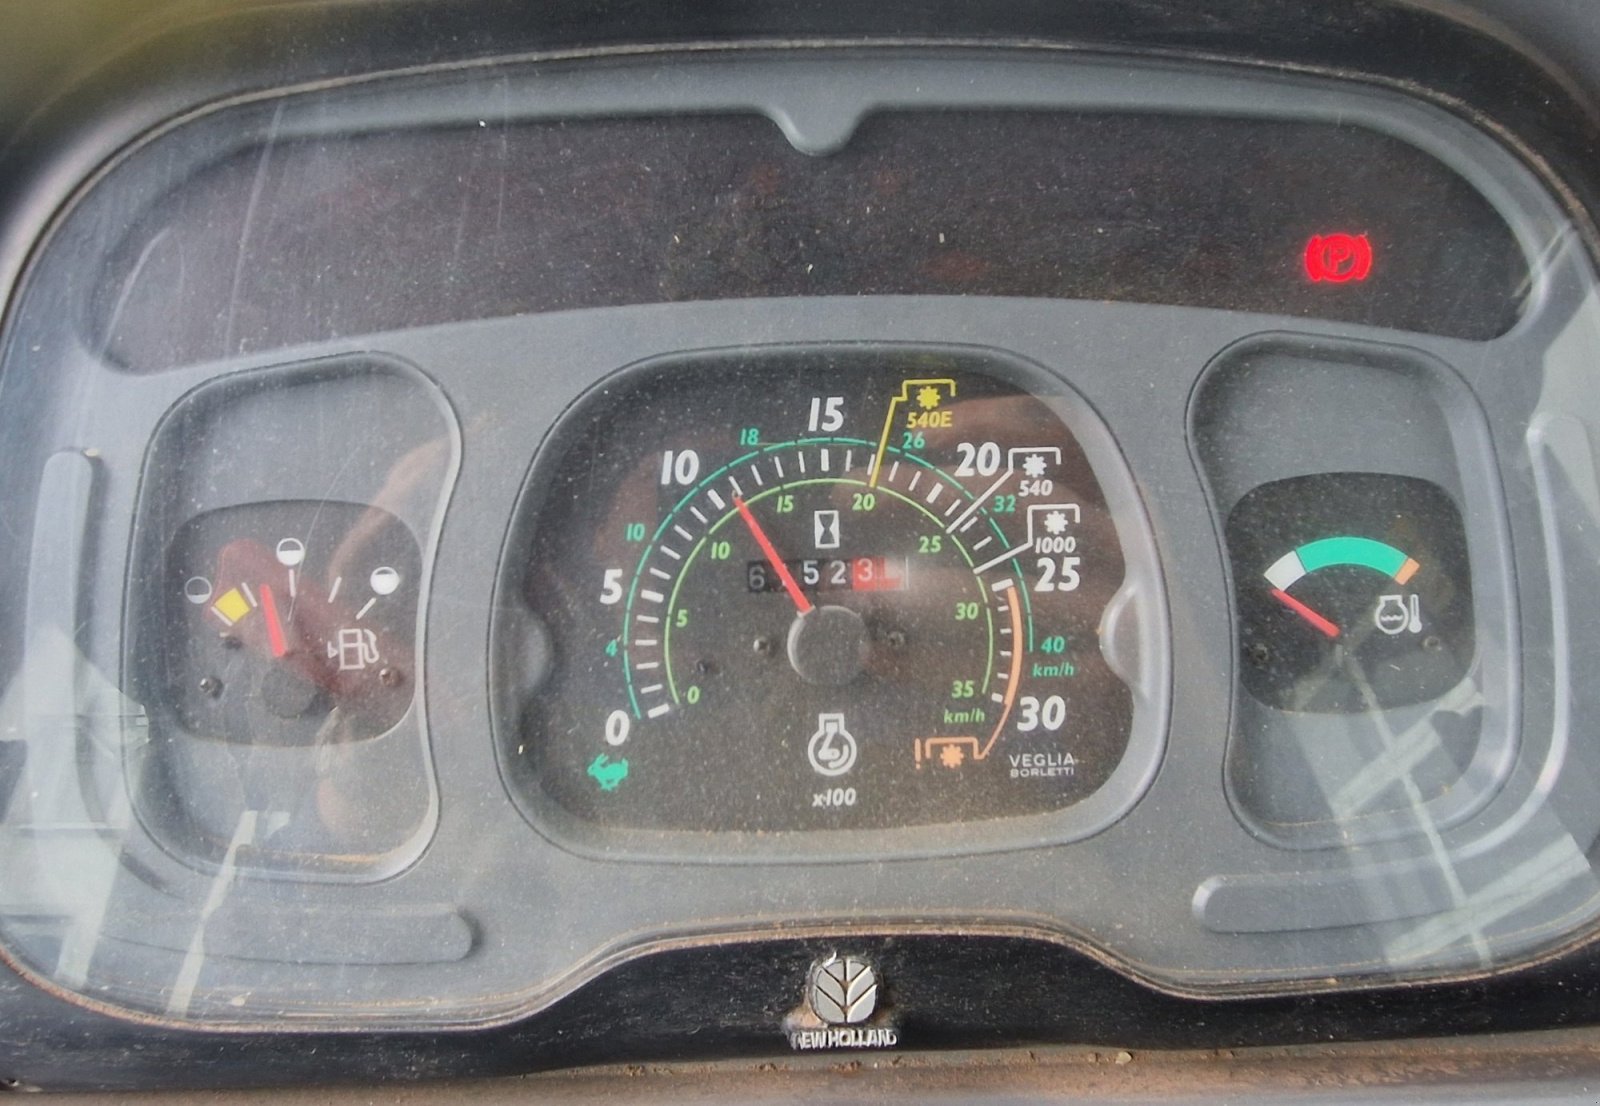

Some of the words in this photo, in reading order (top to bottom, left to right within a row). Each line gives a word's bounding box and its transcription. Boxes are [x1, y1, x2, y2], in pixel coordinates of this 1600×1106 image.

[808, 397, 845, 432] 15
[906, 411, 953, 429] 540E
[740, 428, 760, 445] 18
[903, 432, 925, 449] 26
[660, 450, 700, 485] 10
[954, 442, 1001, 477] 20
[1018, 480, 1053, 497] 540
[776, 495, 795, 513] 15
[852, 493, 876, 511] 20
[993, 495, 1016, 512] 32
[626, 523, 646, 541] 10
[711, 542, 731, 560] 10
[919, 536, 942, 553] 25
[1034, 537, 1076, 554] 1000
[1034, 557, 1081, 592] 25
[600, 568, 623, 605] 5
[676, 609, 688, 628] 5
[955, 603, 979, 620] 30
[605, 639, 618, 657] 4
[1041, 636, 1065, 653] 40
[1032, 663, 1075, 678] km/h
[687, 685, 700, 704] 0
[951, 680, 975, 698] 35
[943, 707, 986, 724] km/h
[1016, 694, 1066, 731] 30
[605, 709, 631, 746] 0
[1009, 752, 1076, 767] VEGLIA
[1010, 767, 1075, 778] BORLETTI
[811, 788, 857, 808] x100
[790, 1031, 827, 1050] NEW
[828, 1028, 897, 1048] HOLLAND
